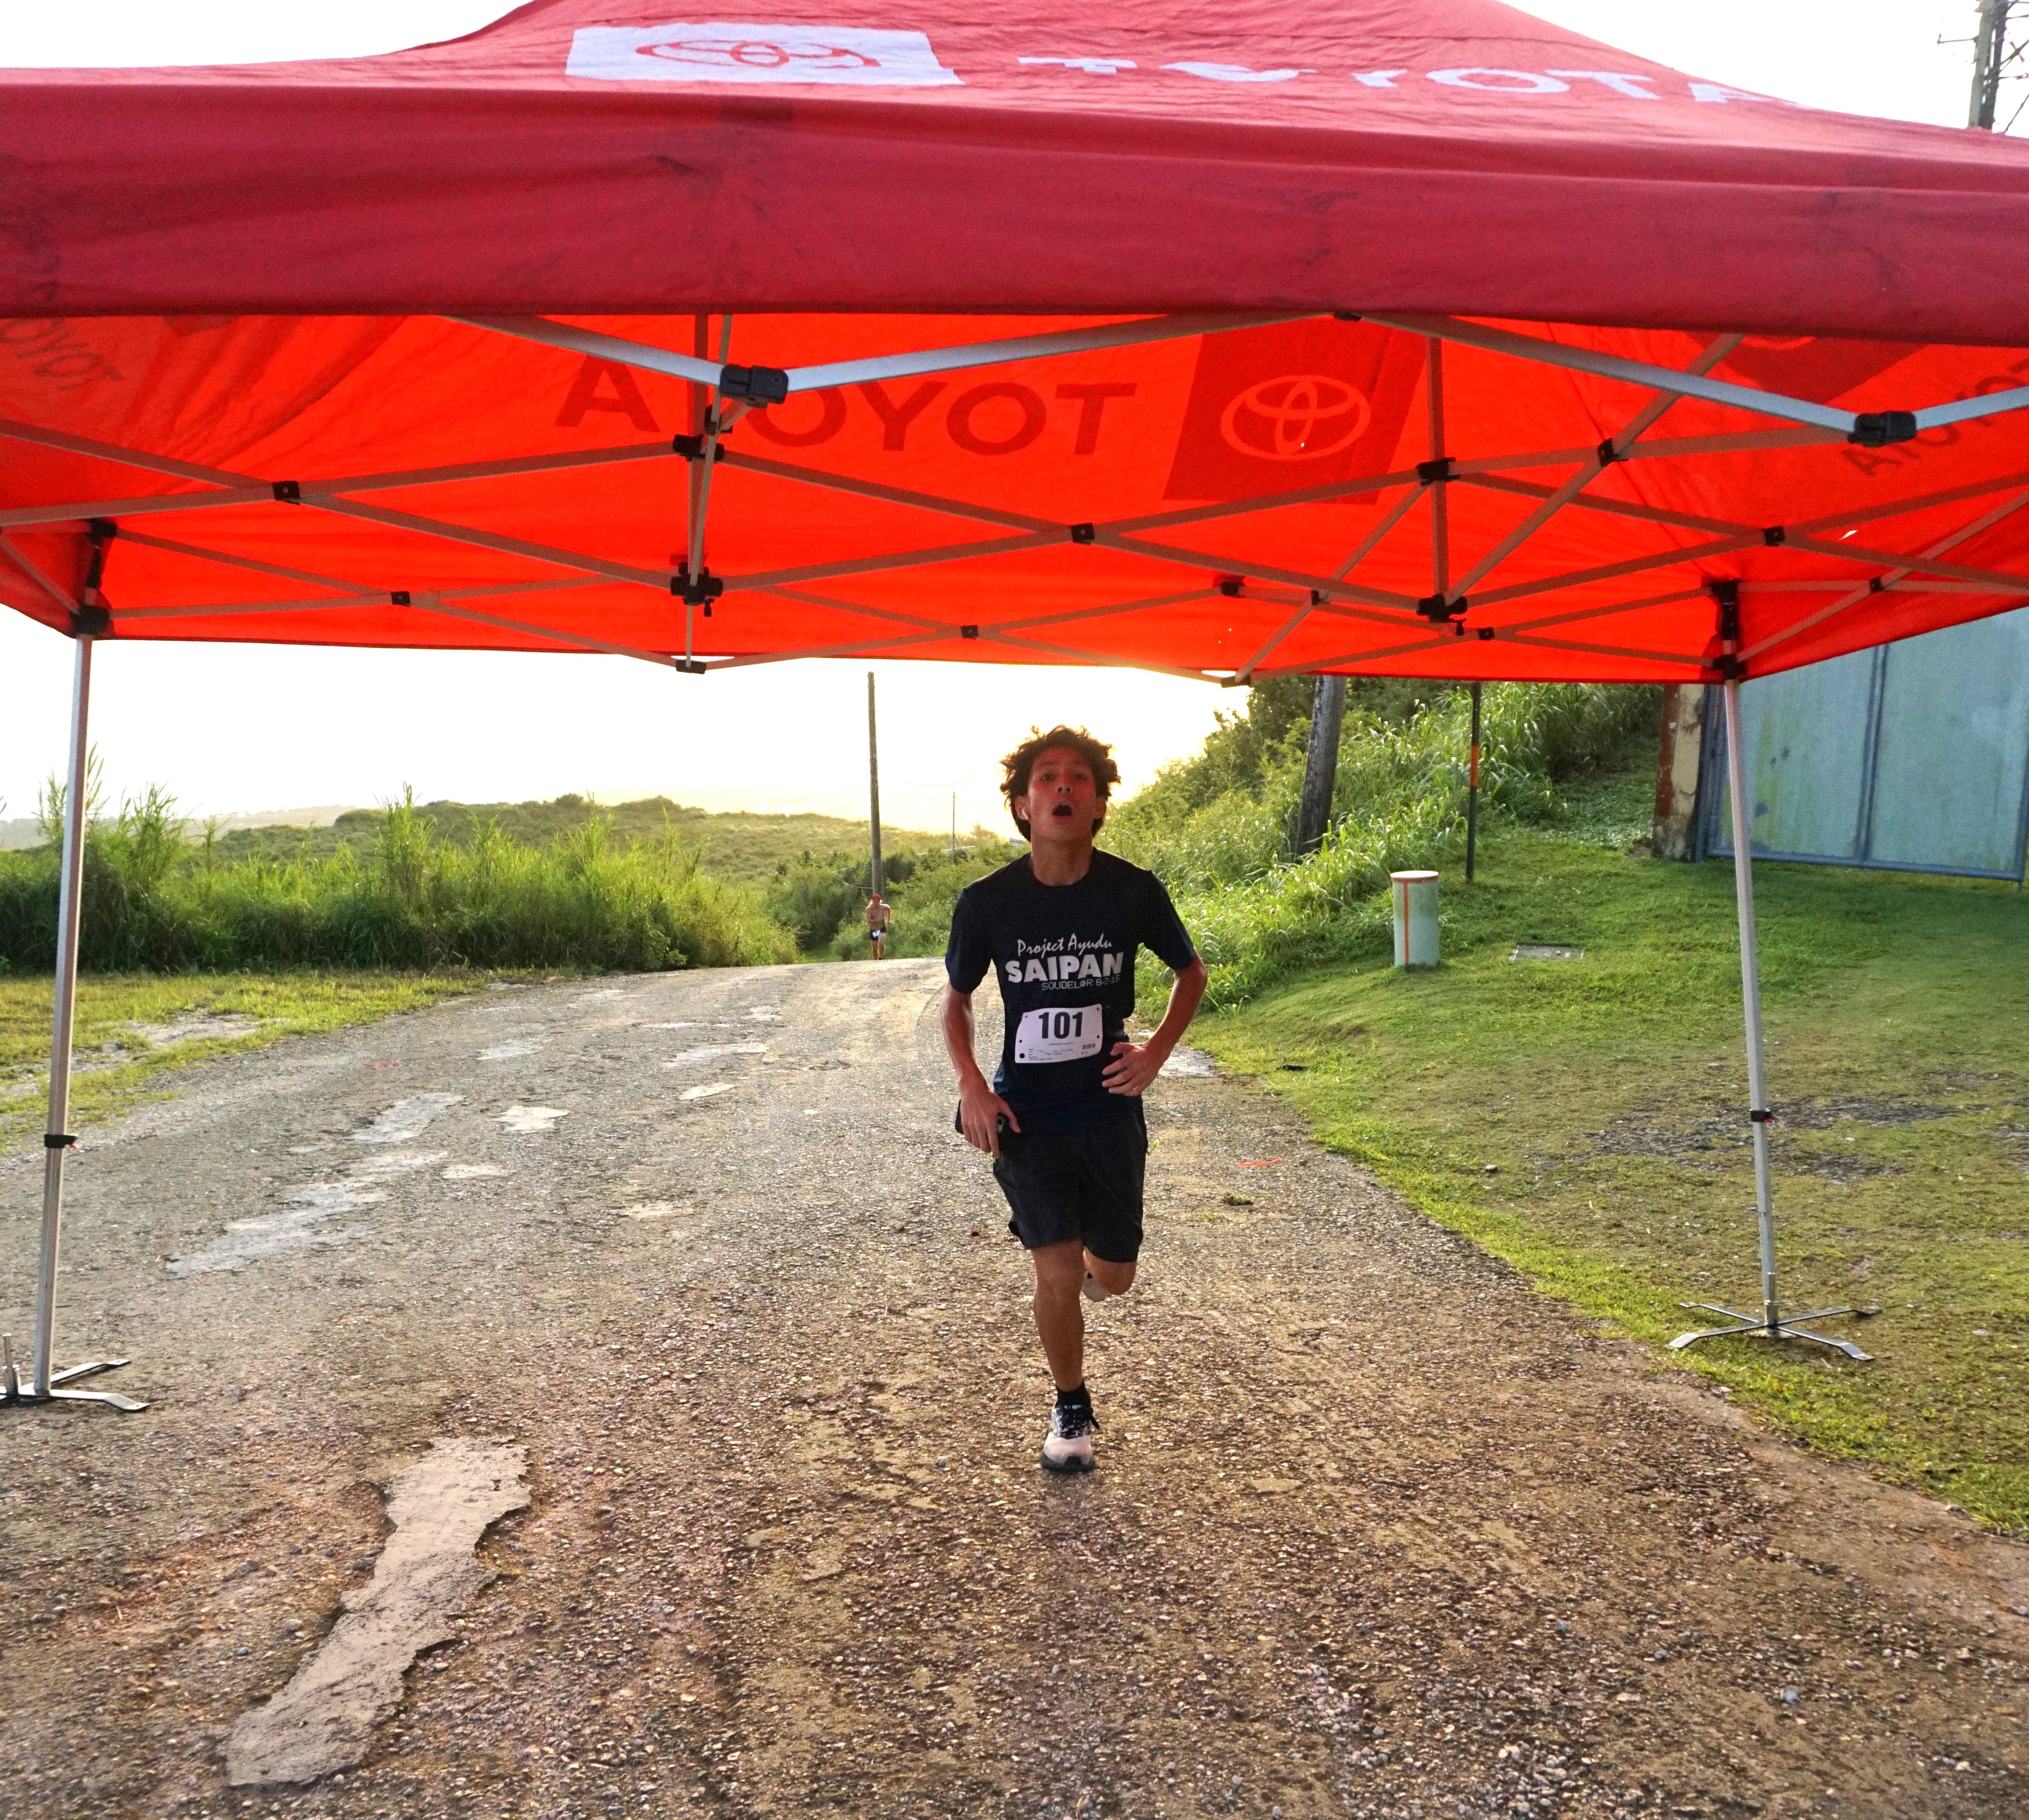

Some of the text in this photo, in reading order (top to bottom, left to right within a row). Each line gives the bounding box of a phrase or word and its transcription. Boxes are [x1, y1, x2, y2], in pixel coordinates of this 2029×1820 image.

[1017, 937, 1064, 959] Project
[1005, 952, 1124, 983] SAIPAN
[1042, 978, 1093, 990] SOUDELOR
[1039, 1012, 1083, 1040] 101
